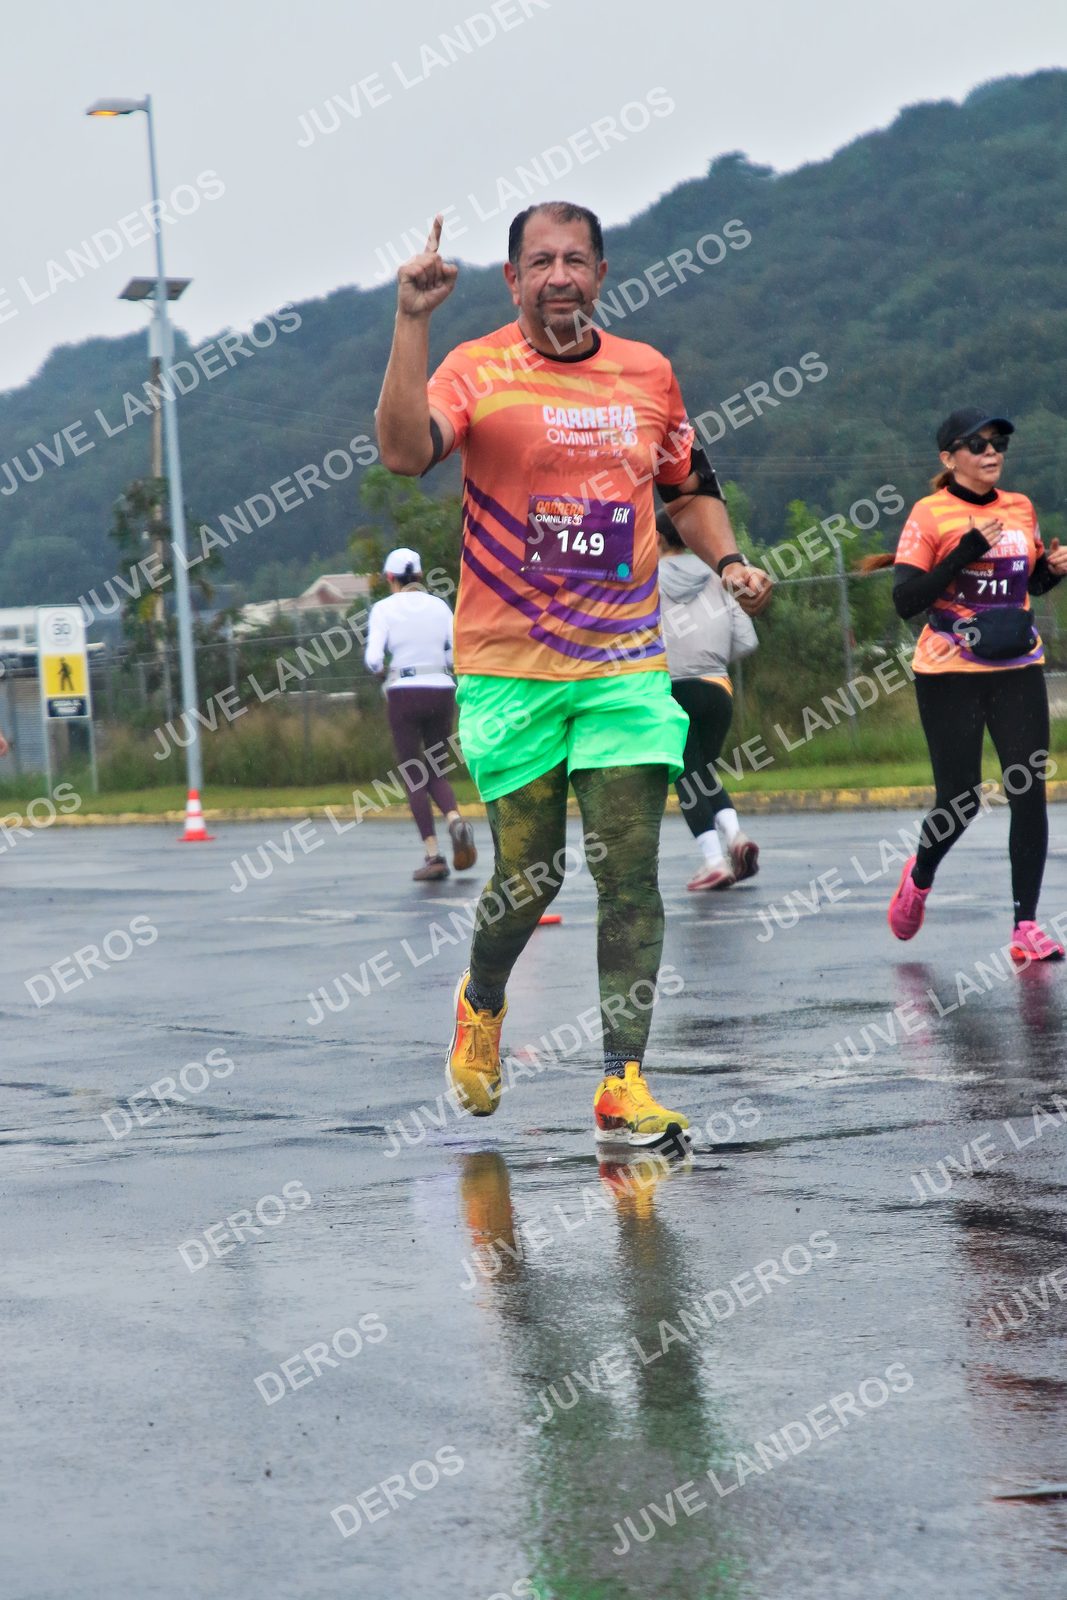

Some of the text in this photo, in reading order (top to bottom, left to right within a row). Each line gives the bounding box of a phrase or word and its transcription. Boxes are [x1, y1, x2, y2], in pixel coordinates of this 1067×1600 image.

[543, 404, 637, 429] CARRERA
[547, 428, 619, 446] OMNILIFE
[536, 500, 585, 515] CARRERA
[535, 514, 572, 525] OMNILIFE
[557, 530, 605, 556] 149
[977, 579, 1008, 595] 711
